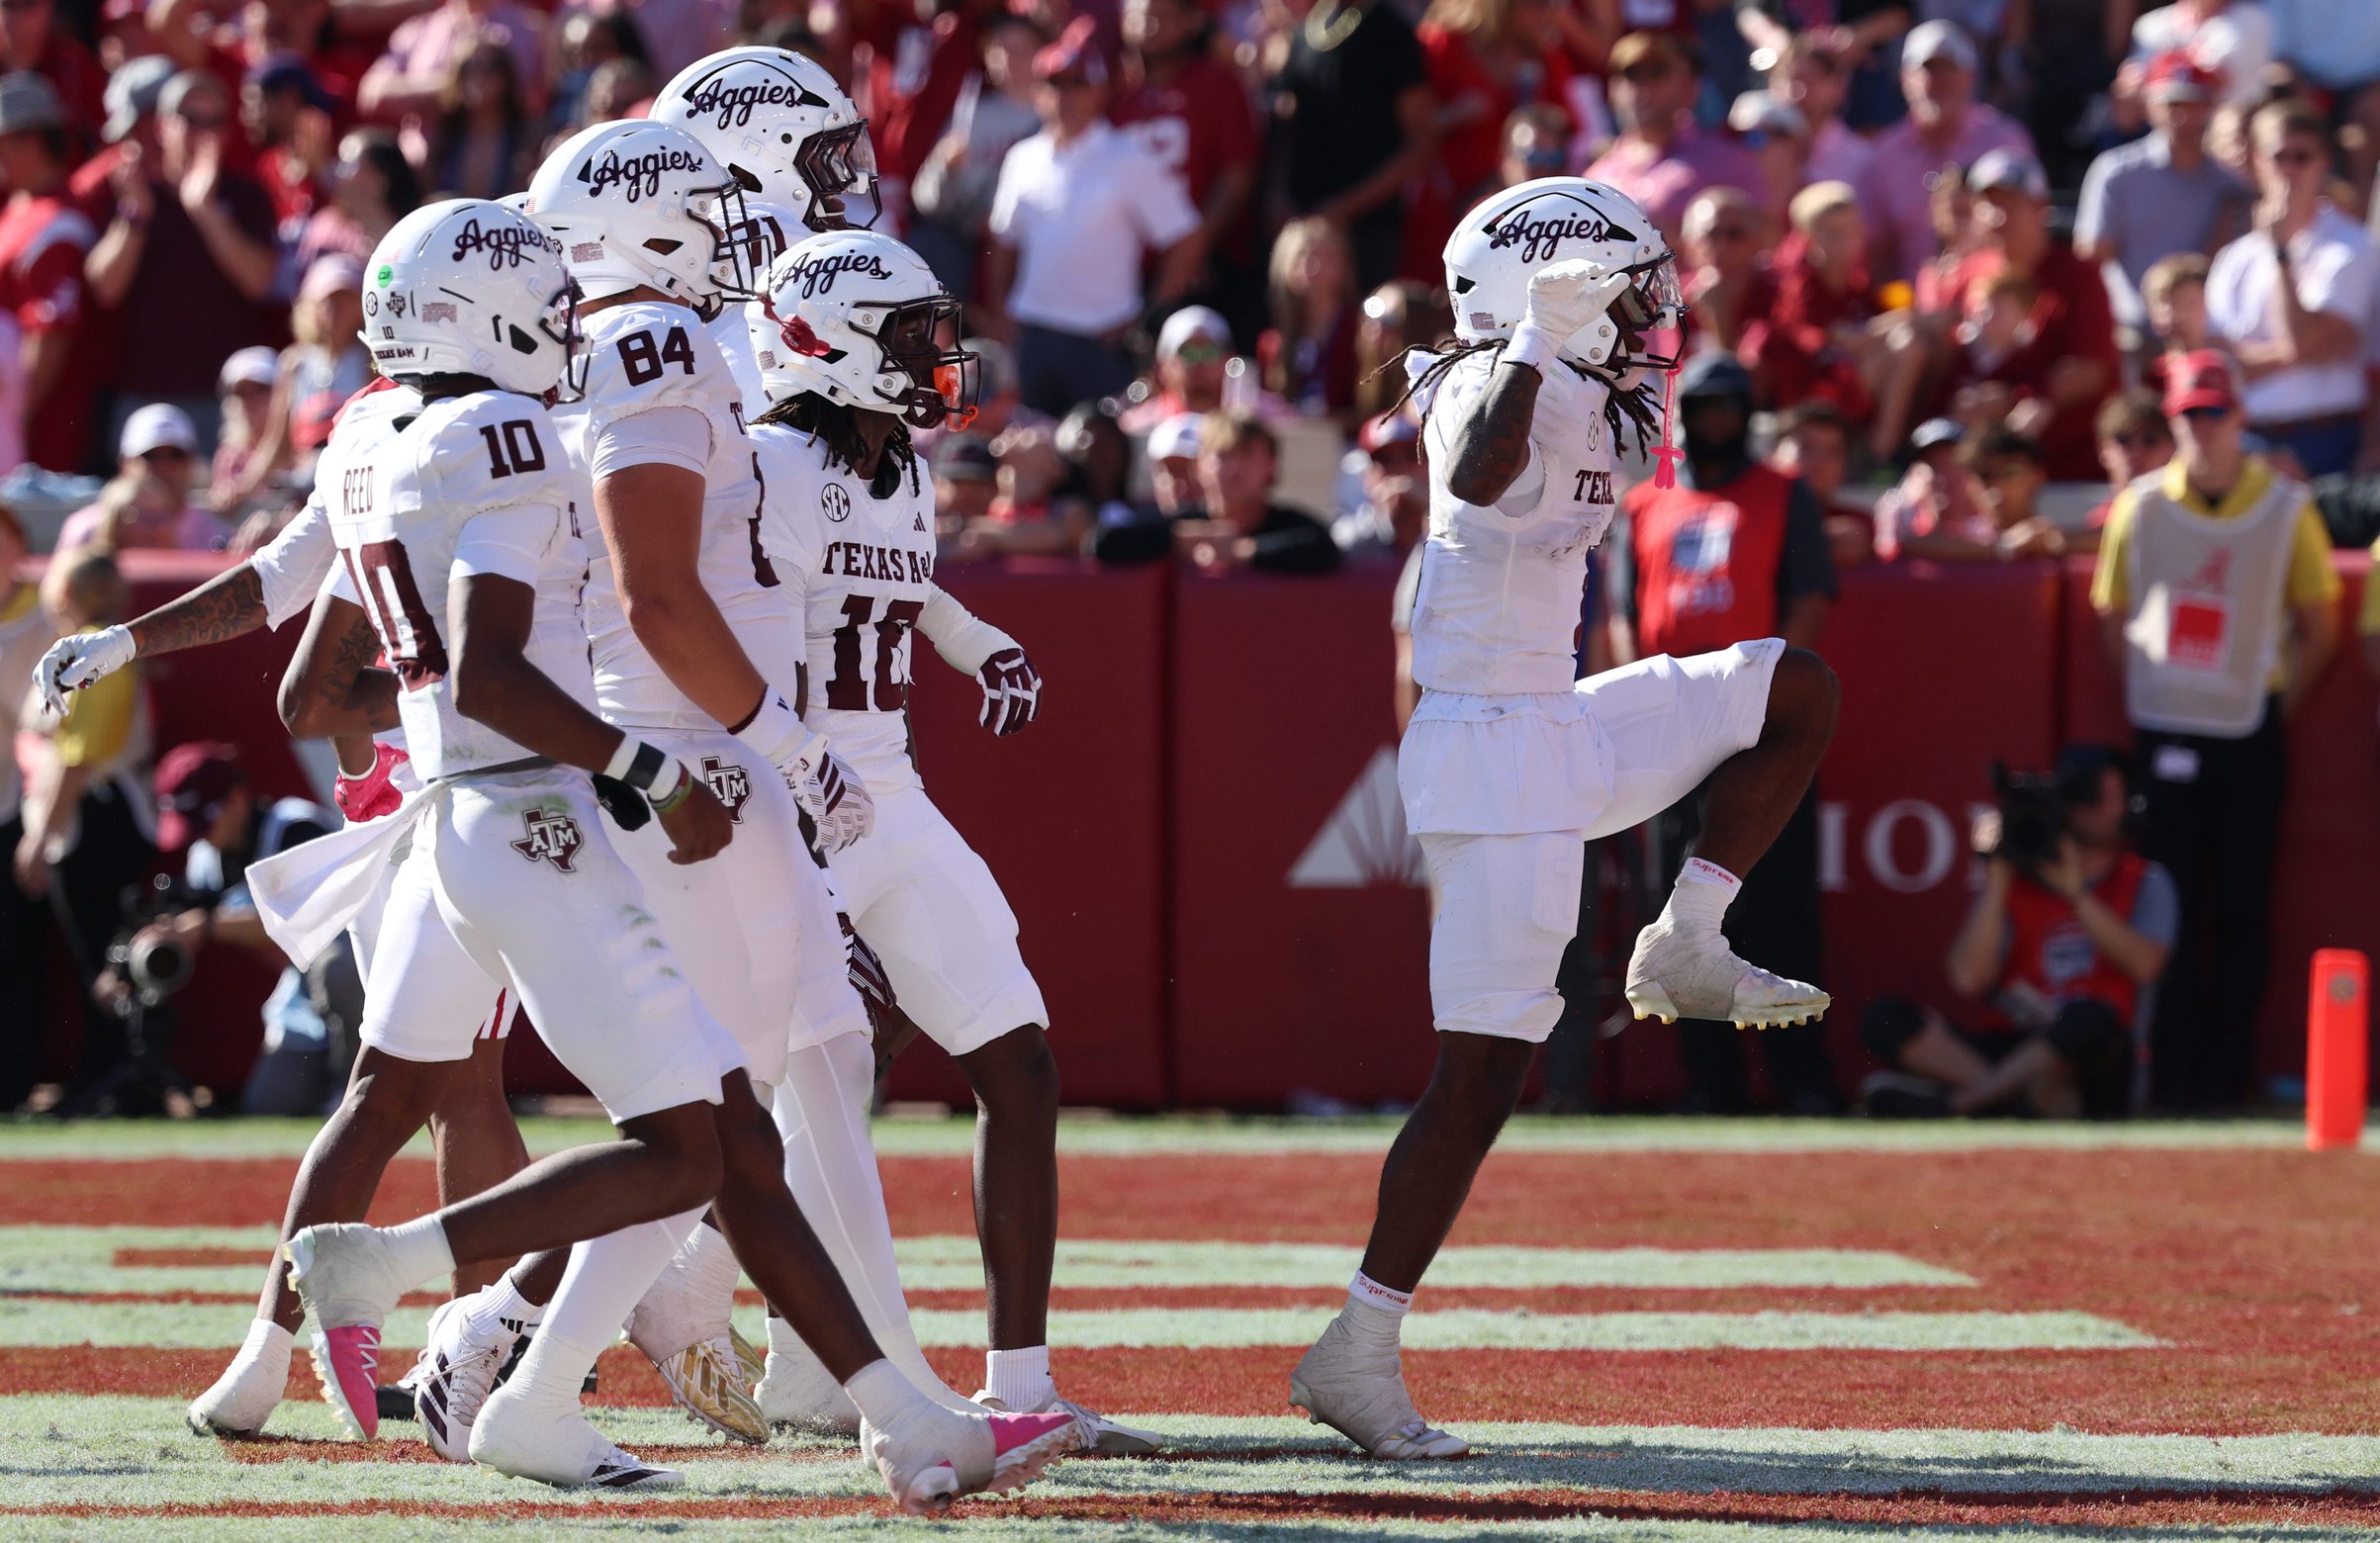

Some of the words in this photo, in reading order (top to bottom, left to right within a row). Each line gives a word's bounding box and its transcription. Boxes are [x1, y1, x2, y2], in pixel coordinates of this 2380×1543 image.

[687, 78, 802, 130] Aggies
[590, 145, 702, 203] Aggies
[452, 218, 550, 271] Aggies
[1490, 208, 1609, 263] Aggies
[775, 249, 882, 300] Aggies
[382, 325, 395, 339] 10
[616, 326, 695, 387] 84
[480, 419, 546, 479] 10
[343, 465, 373, 515] REED
[823, 485, 850, 520] SEC
[822, 542, 905, 582] TEXAS
[1693, 859, 1735, 884] Supreme
[1358, 1276, 1409, 1305] Supreme
